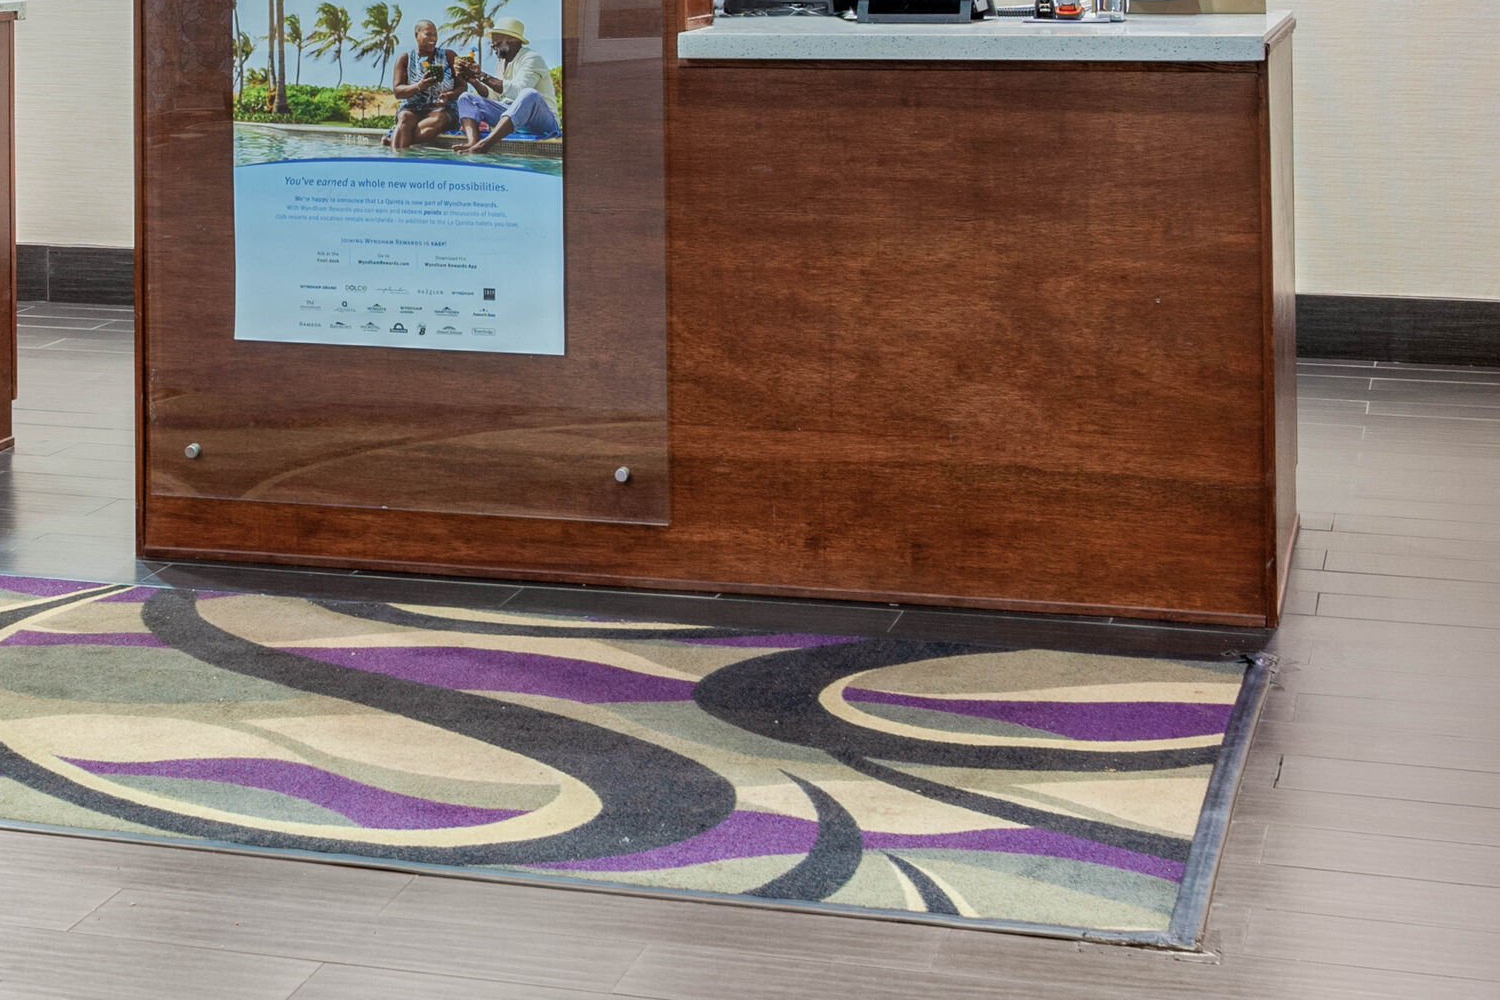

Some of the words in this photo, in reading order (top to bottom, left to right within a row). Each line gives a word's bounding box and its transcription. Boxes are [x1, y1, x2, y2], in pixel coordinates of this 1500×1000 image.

[285, 176, 314, 186] You've
[316, 178, 348, 187] earned
[358, 179, 385, 188] whole
[409, 180, 434, 190] world
[438, 181, 447, 190] of
[449, 181, 509, 192] possibilities.
